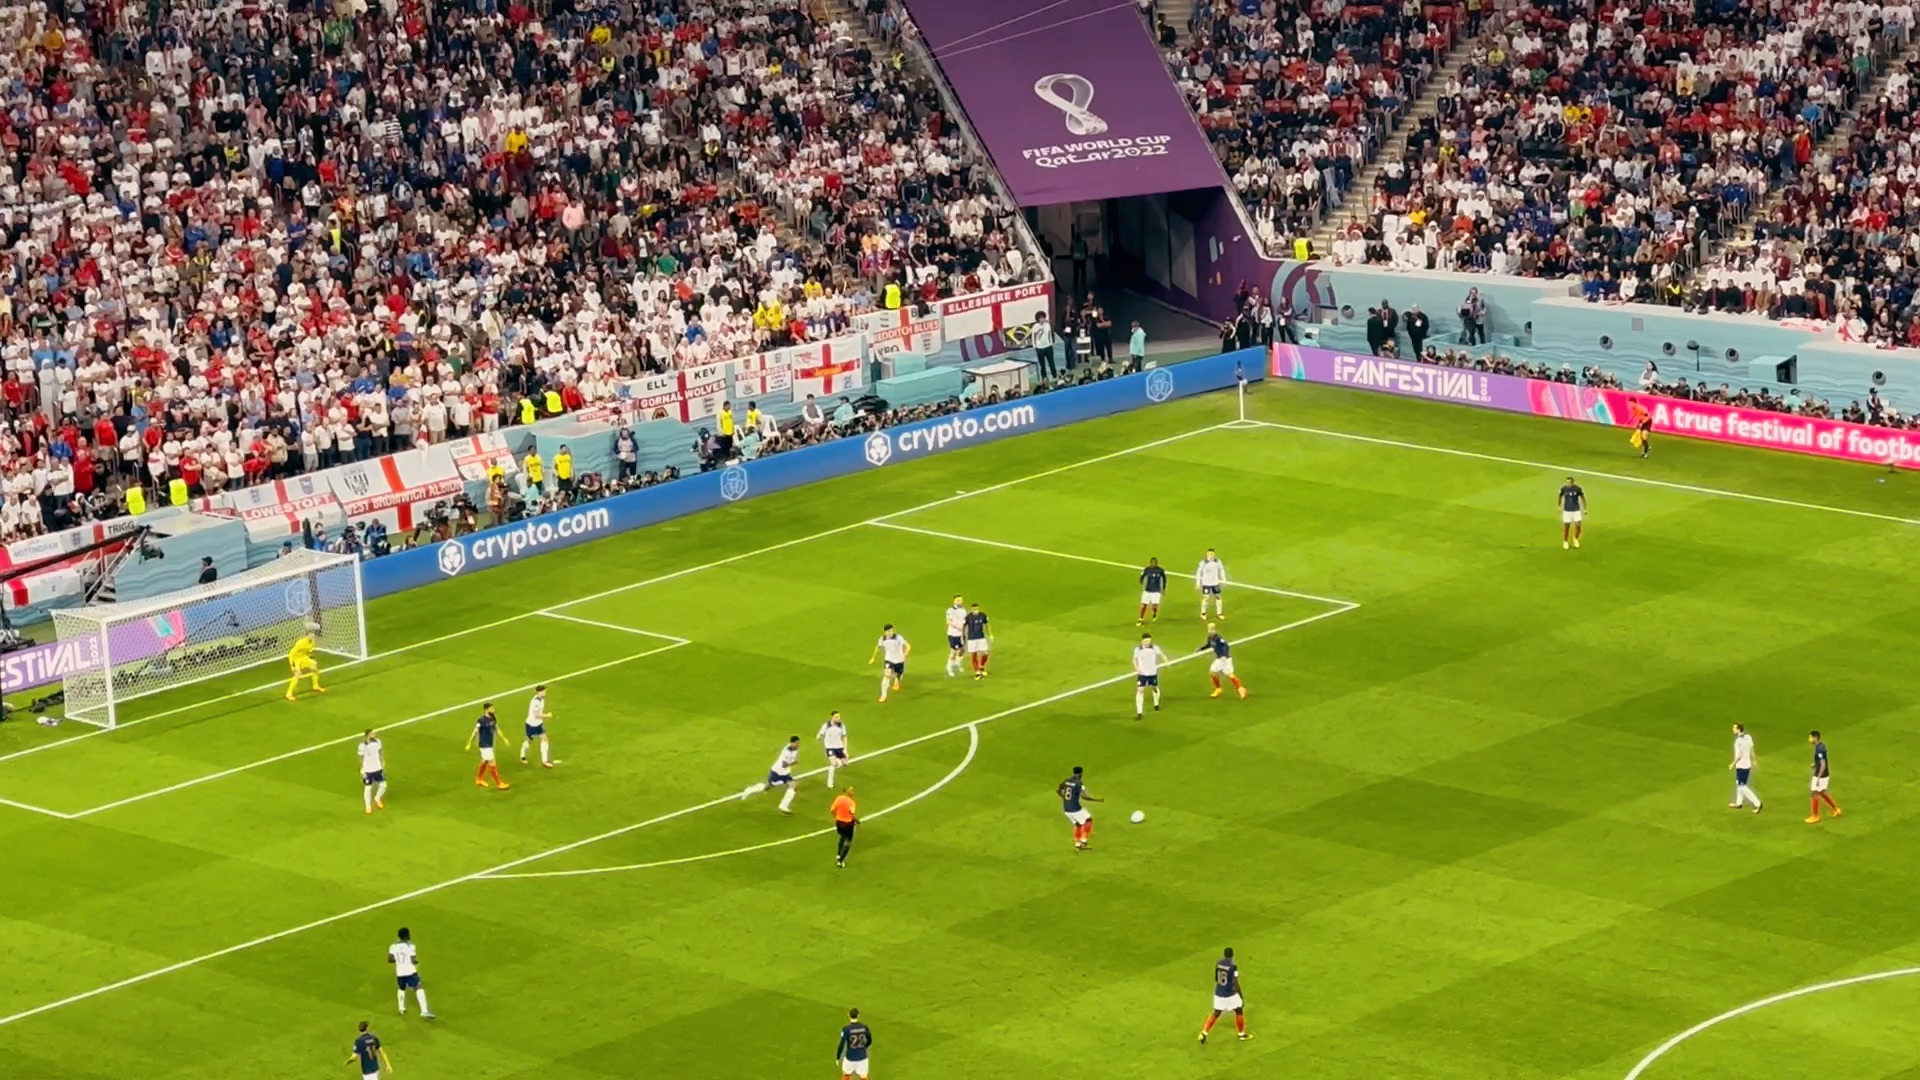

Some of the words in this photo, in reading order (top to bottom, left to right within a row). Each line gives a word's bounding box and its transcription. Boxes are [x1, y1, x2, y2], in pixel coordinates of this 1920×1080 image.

[1022, 146, 1065, 159] FIFA
[1064, 138, 1133, 153] WORLD
[1135, 135, 1172, 145] CUP
[948, 292, 1012, 313] ELLESMERE
[1015, 285, 1044, 298] PORT
[914, 319, 939, 332] BLUES
[647, 379, 668, 391] ELL
[694, 367, 717, 380] KEV
[684, 379, 726, 399] WOLVES
[898, 404, 1036, 451] crypto.com
[1654, 403, 1670, 426] A
[1674, 407, 1722, 433] true
[1727, 413, 1813, 447] festival
[1818, 428, 1844, 450] of
[242, 493, 330, 520] LOWESTOFT
[372, 490, 426, 509] BROMWICH
[471, 506, 609, 560] crypto.com
